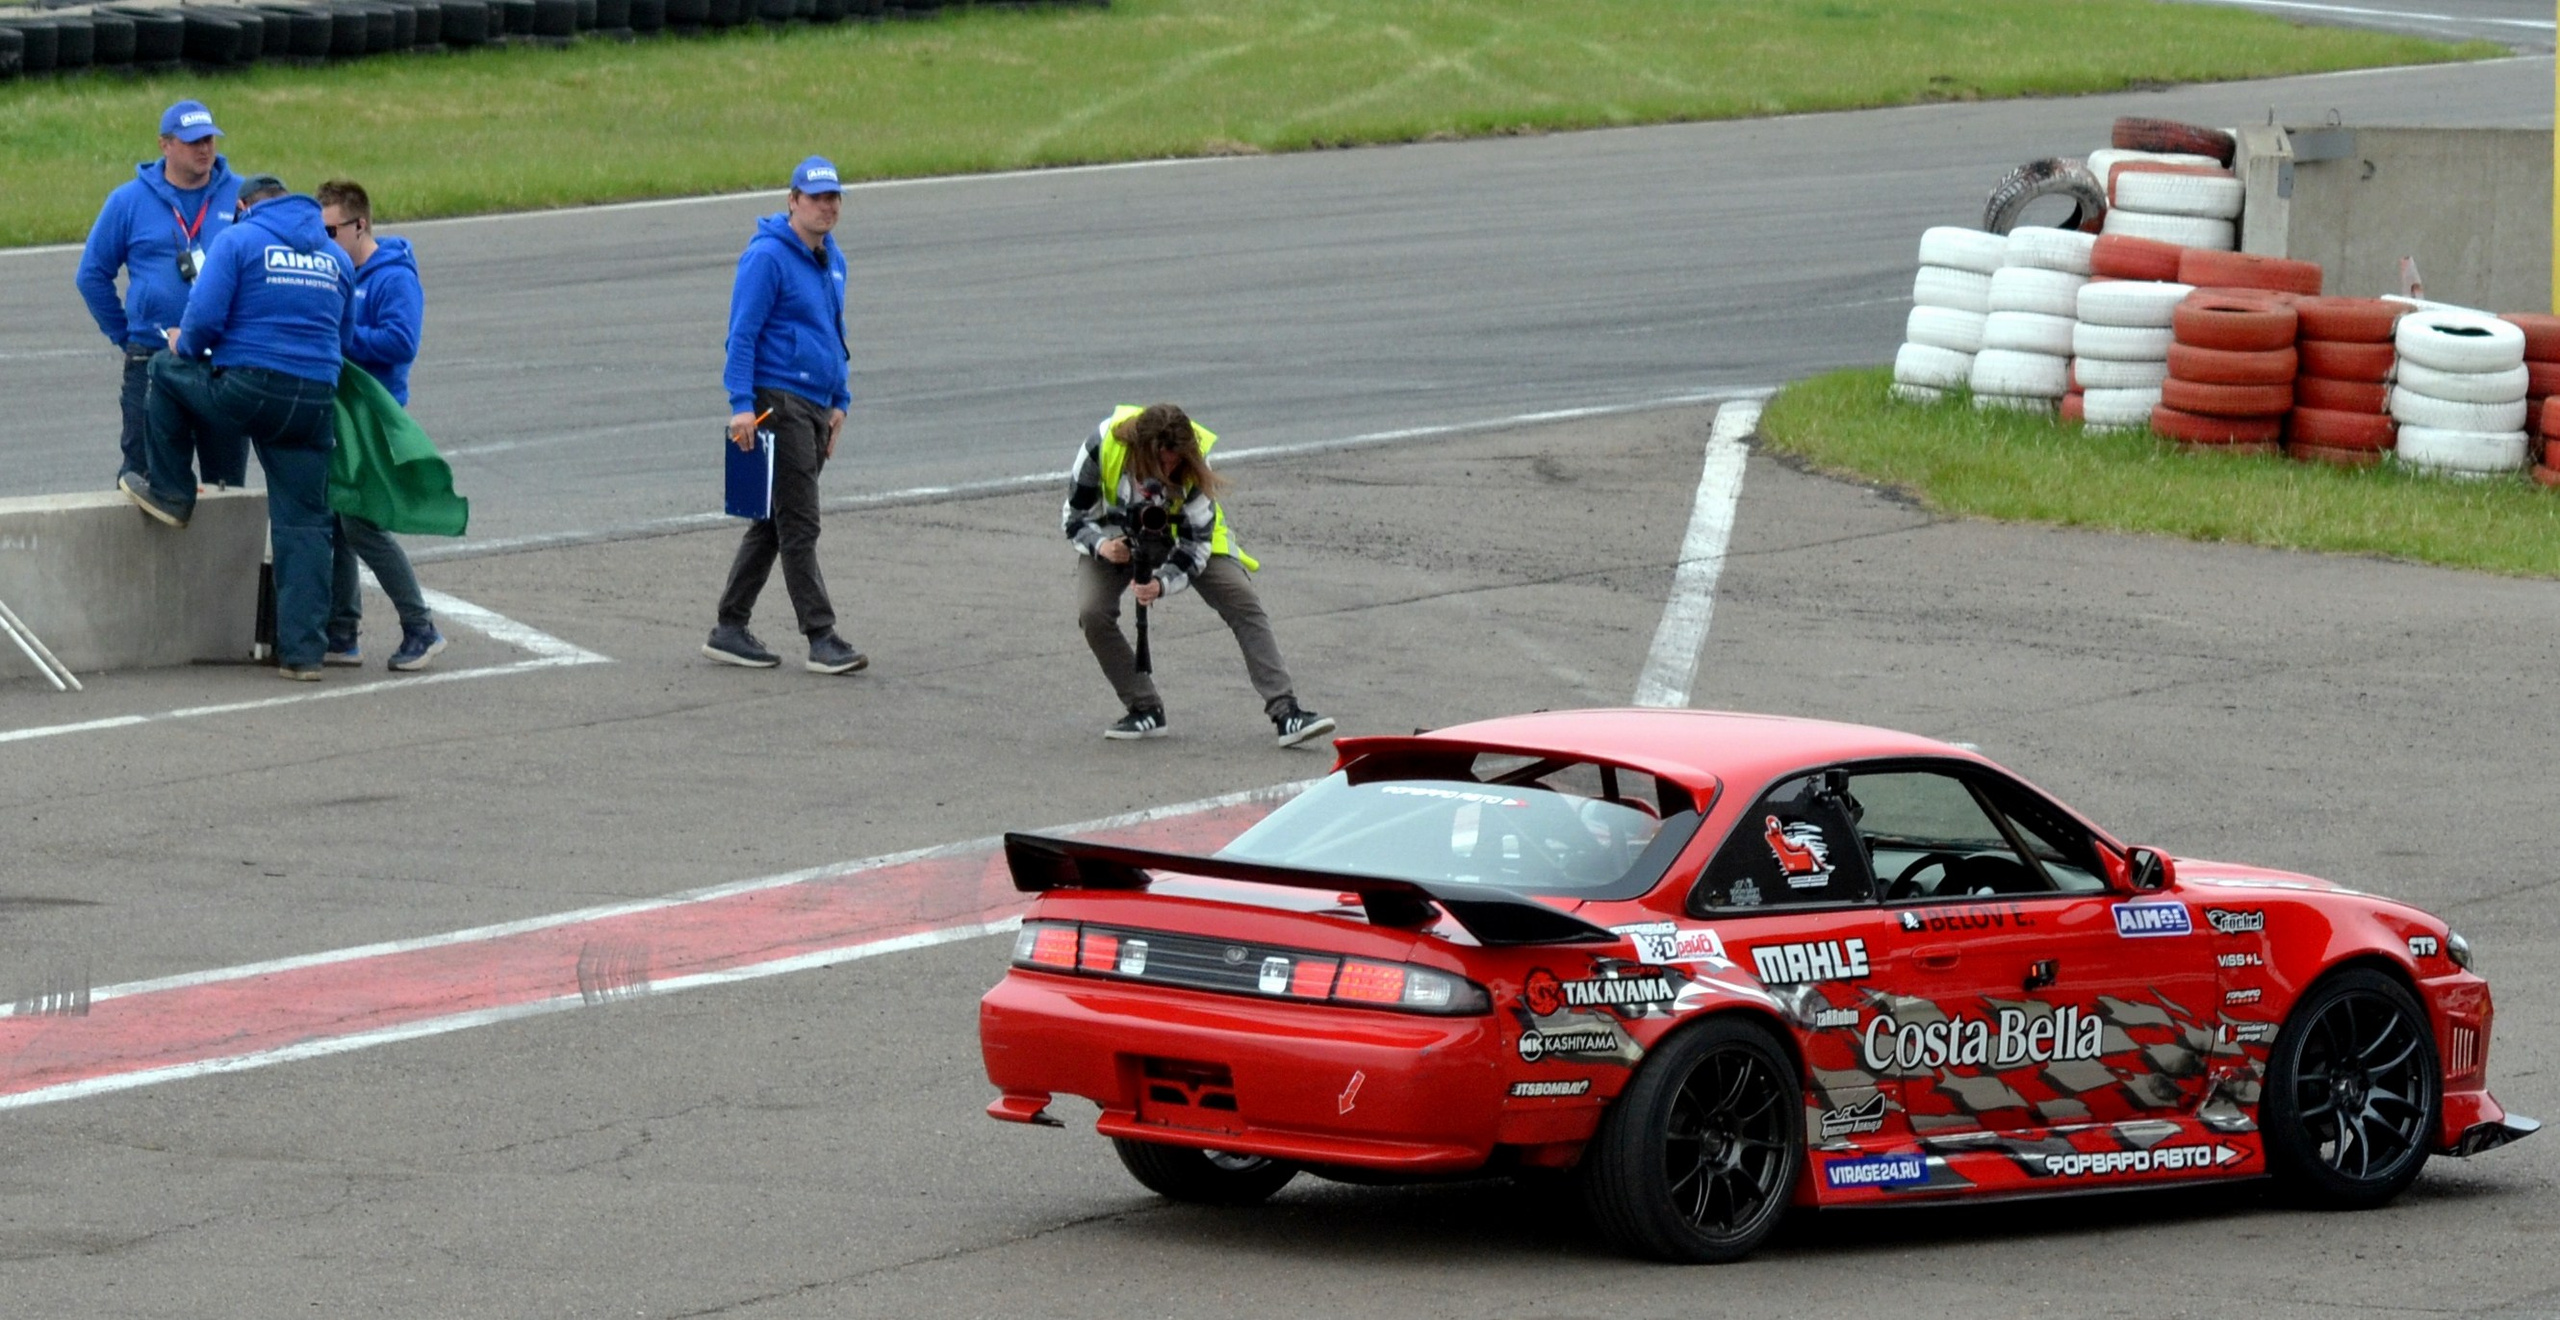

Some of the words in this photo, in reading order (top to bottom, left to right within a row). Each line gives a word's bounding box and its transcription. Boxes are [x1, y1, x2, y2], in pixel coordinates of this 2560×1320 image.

[270, 251, 336, 277] AIMOL
[1931, 907, 2005, 932] BELOV
[2120, 907, 2187, 930] AIMOL
[2408, 936, 2438, 956] CTR
[1752, 938, 1870, 983] MAHLE
[1562, 977, 1674, 1005] TAKAYAMA
[1544, 1035, 1616, 1052] KASHIYAMA
[1864, 1013, 1989, 1071] Costa
[1996, 1006, 2104, 1064] Bella
[1829, 1161, 1920, 1184] VIRAGE24.RU
[2046, 1150, 2150, 1175] ФОРВАРД
[2154, 1146, 2211, 1170] АВТО
